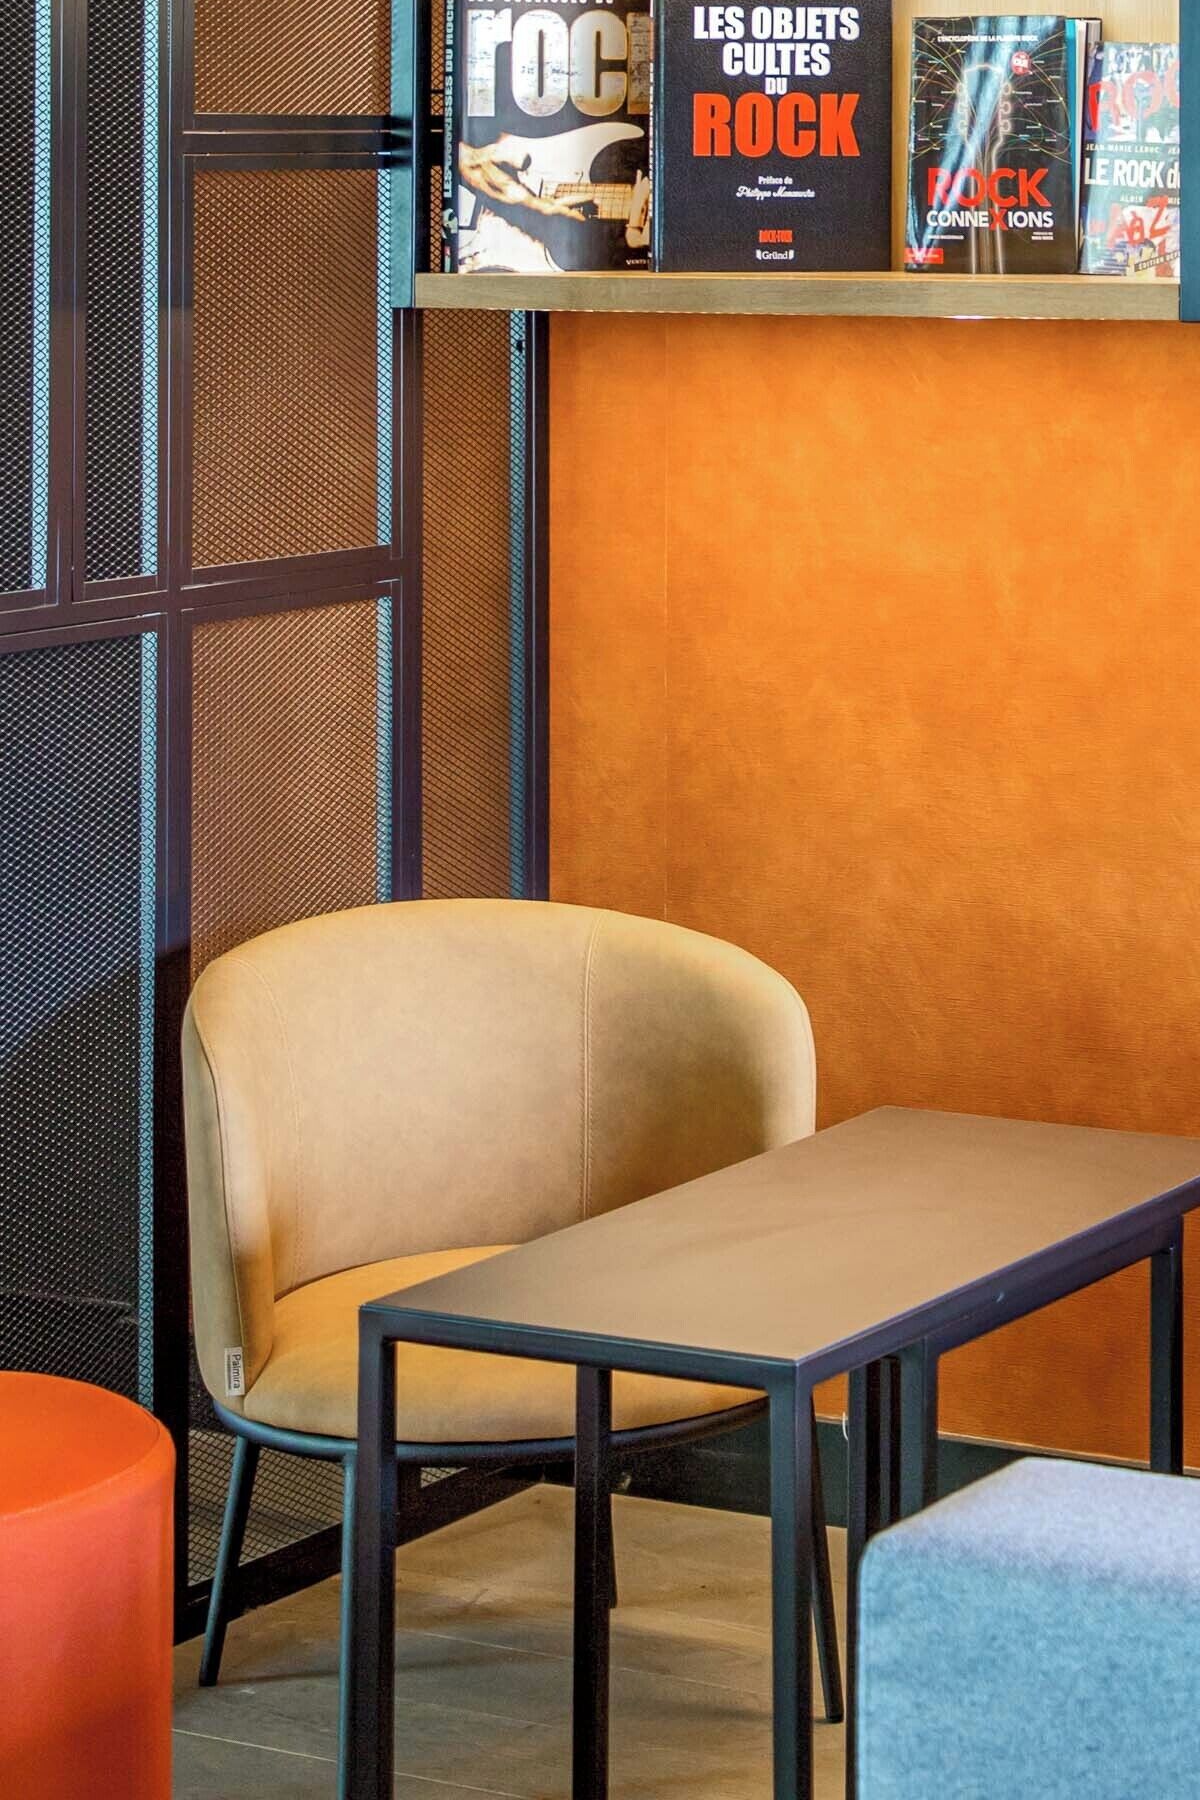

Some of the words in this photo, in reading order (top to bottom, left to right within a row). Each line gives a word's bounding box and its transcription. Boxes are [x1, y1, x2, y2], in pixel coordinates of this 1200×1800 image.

[693, 6, 745, 40] LES
[751, 6, 861, 41] OBJETS
[722, 41, 831, 77] CULTES
[764, 76, 788, 96] DU
[692, 91, 861, 158] ROCK
[927, 167, 1052, 208] ROCK
[1084, 158, 1110, 186] LE
[1113, 159, 1165, 189] ROCK
[1166, 163, 1180, 189] d
[926, 208, 1054, 231] CONNEXIONS
[761, 251, 788, 260] Gründ
[232, 1354, 241, 1389] Palmira
